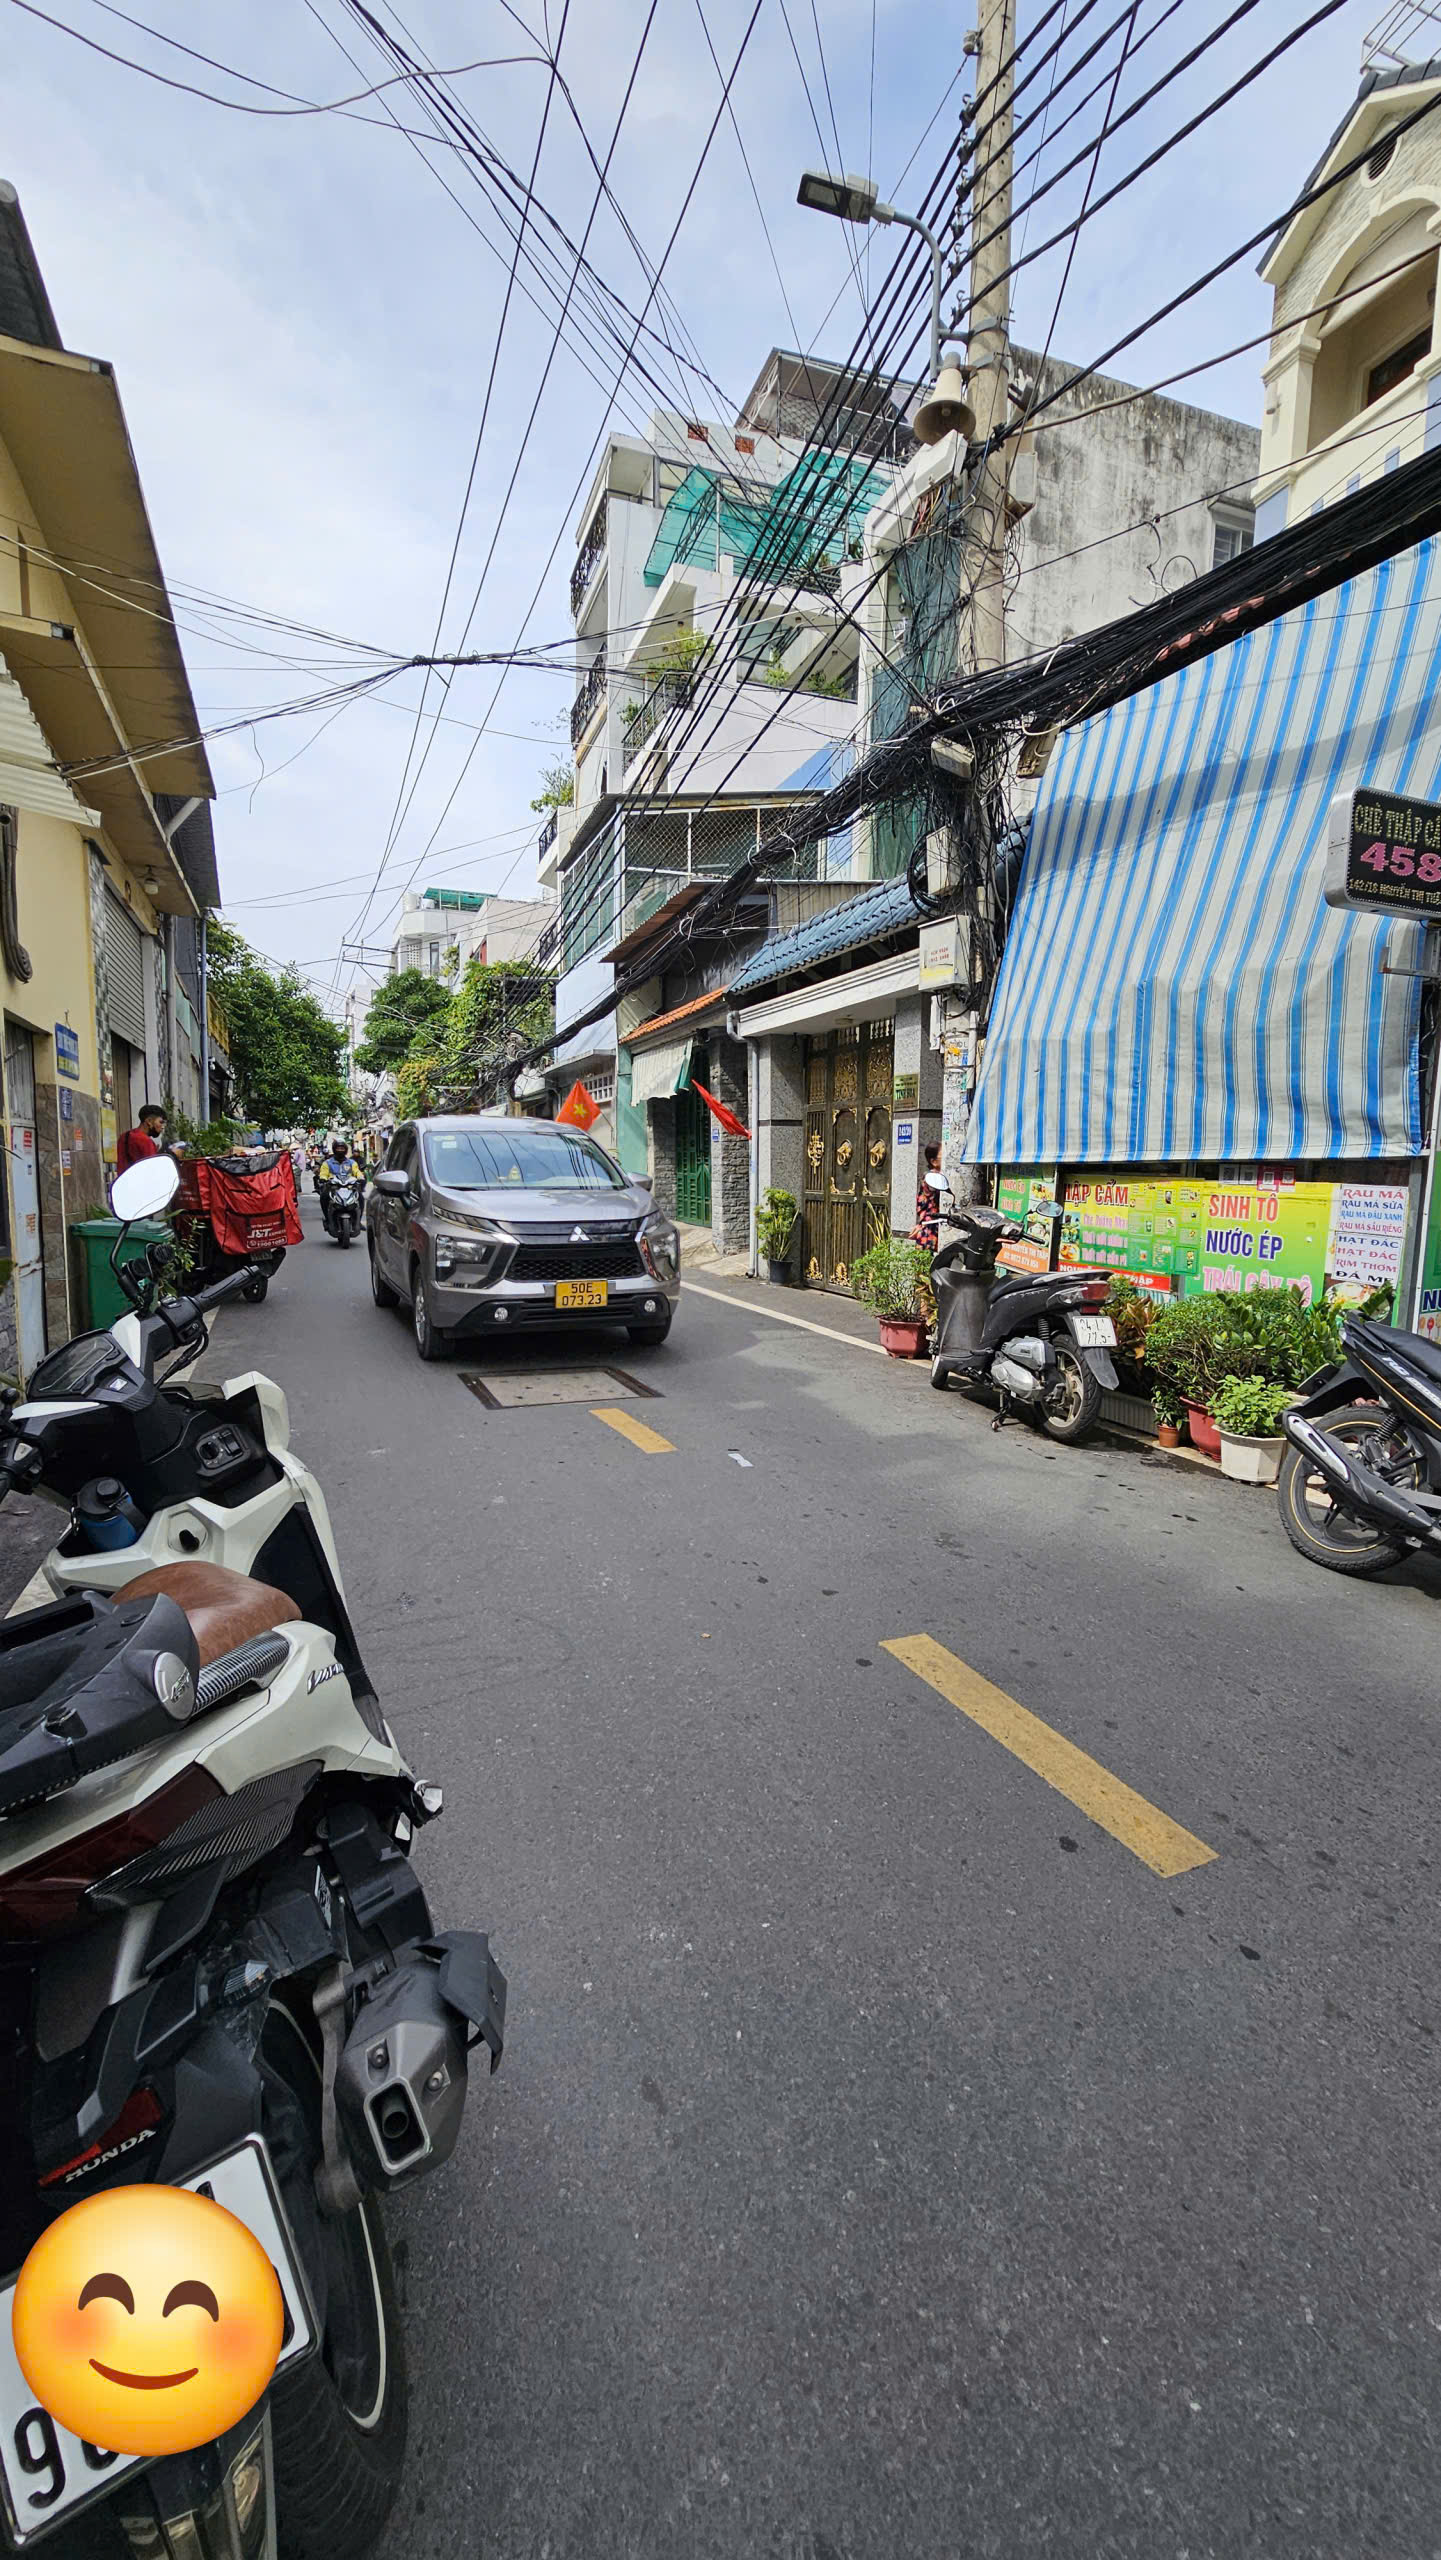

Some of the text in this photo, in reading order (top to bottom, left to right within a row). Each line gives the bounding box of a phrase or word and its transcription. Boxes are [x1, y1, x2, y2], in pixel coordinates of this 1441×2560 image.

[1354, 802, 1382, 836] CHÈ
[1360, 842, 1441, 882] 458
[1064, 1181, 1091, 1206] HẬP
[1095, 1179, 1129, 1206] CẨM
[1344, 1189, 1404, 1199] RAU MÁ
[1209, 1194, 1250, 1219] SINH
[1342, 1199, 1403, 1210] RAU MÁ SỮA
[1341, 1210, 1354, 1219] RAU
[1384, 1212, 1402, 1221] XANH
[1340, 1221, 1353, 1230] RAU
[1355, 1221, 1365, 1230] MÁ
[1382, 1224, 1402, 1233] RIÊNG
[247, 1228, 273, 1239] J&T
[1206, 1227, 1283, 1259] NƯỚC ÉP
[1339, 1236, 1399, 1248] HẠT ĐÁC
[1338, 1248, 1397, 1260] HẠT ĐÁC
[1336, 1259, 1397, 1272] RIM THƠM
[1203, 1265, 1241, 1292] TRÁI
[1336, 1270, 1360, 1279] ĐÁ
[571, 1283, 593, 1294] 50E
[561, 1294, 602, 1306] 073.23
[65, 2129, 157, 2183] HONDA
